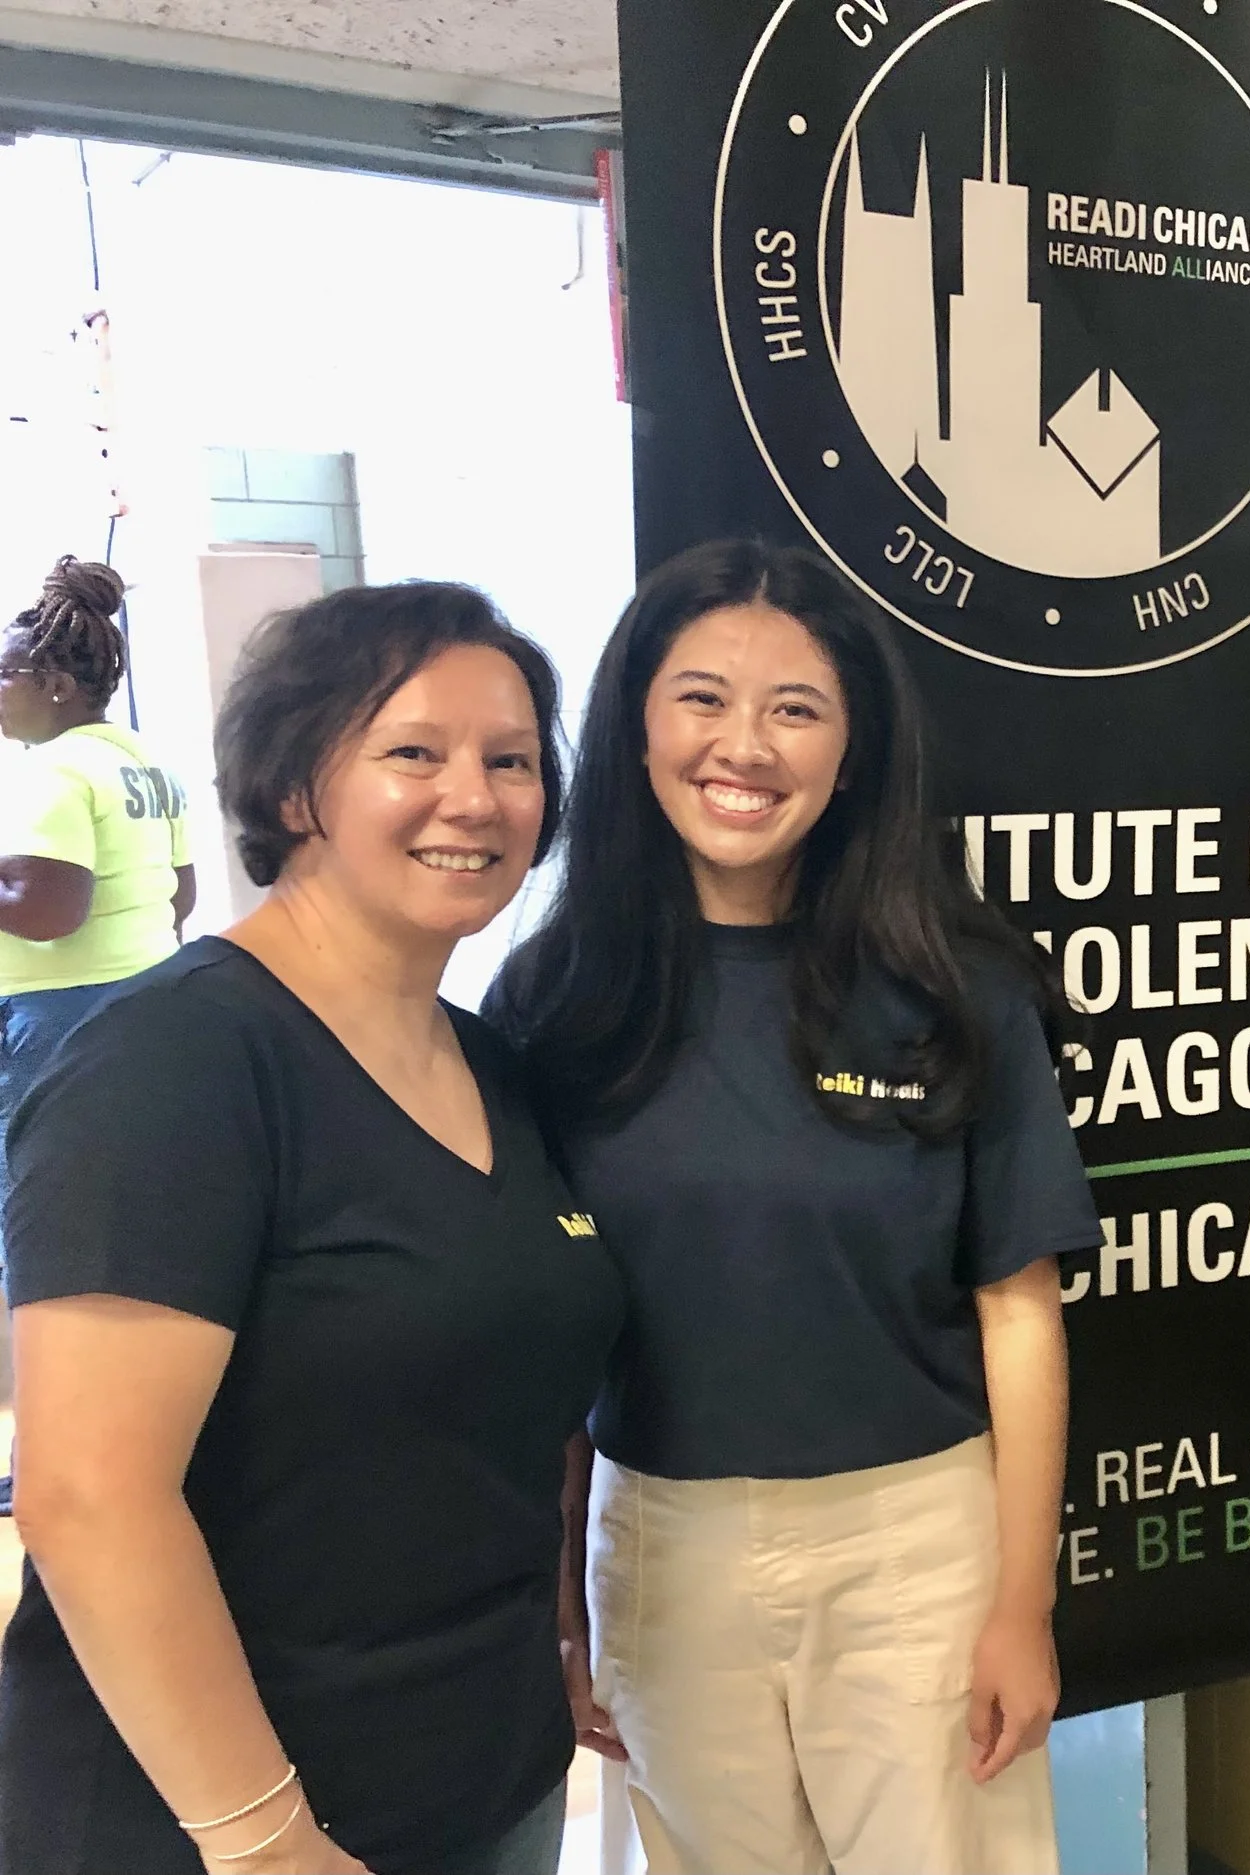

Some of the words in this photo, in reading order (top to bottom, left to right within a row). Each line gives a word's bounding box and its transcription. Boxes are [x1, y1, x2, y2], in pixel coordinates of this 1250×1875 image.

[1048, 193, 1147, 240] READI
[1048, 241, 1167, 276] HEARTLAND
[755, 227, 808, 362] HHCS
[883, 525, 975, 609] LCLC
[1132, 572, 1210, 631] CNH
[1096, 1432, 1237, 1507] REAL
[1136, 1506, 1205, 1571] BE
